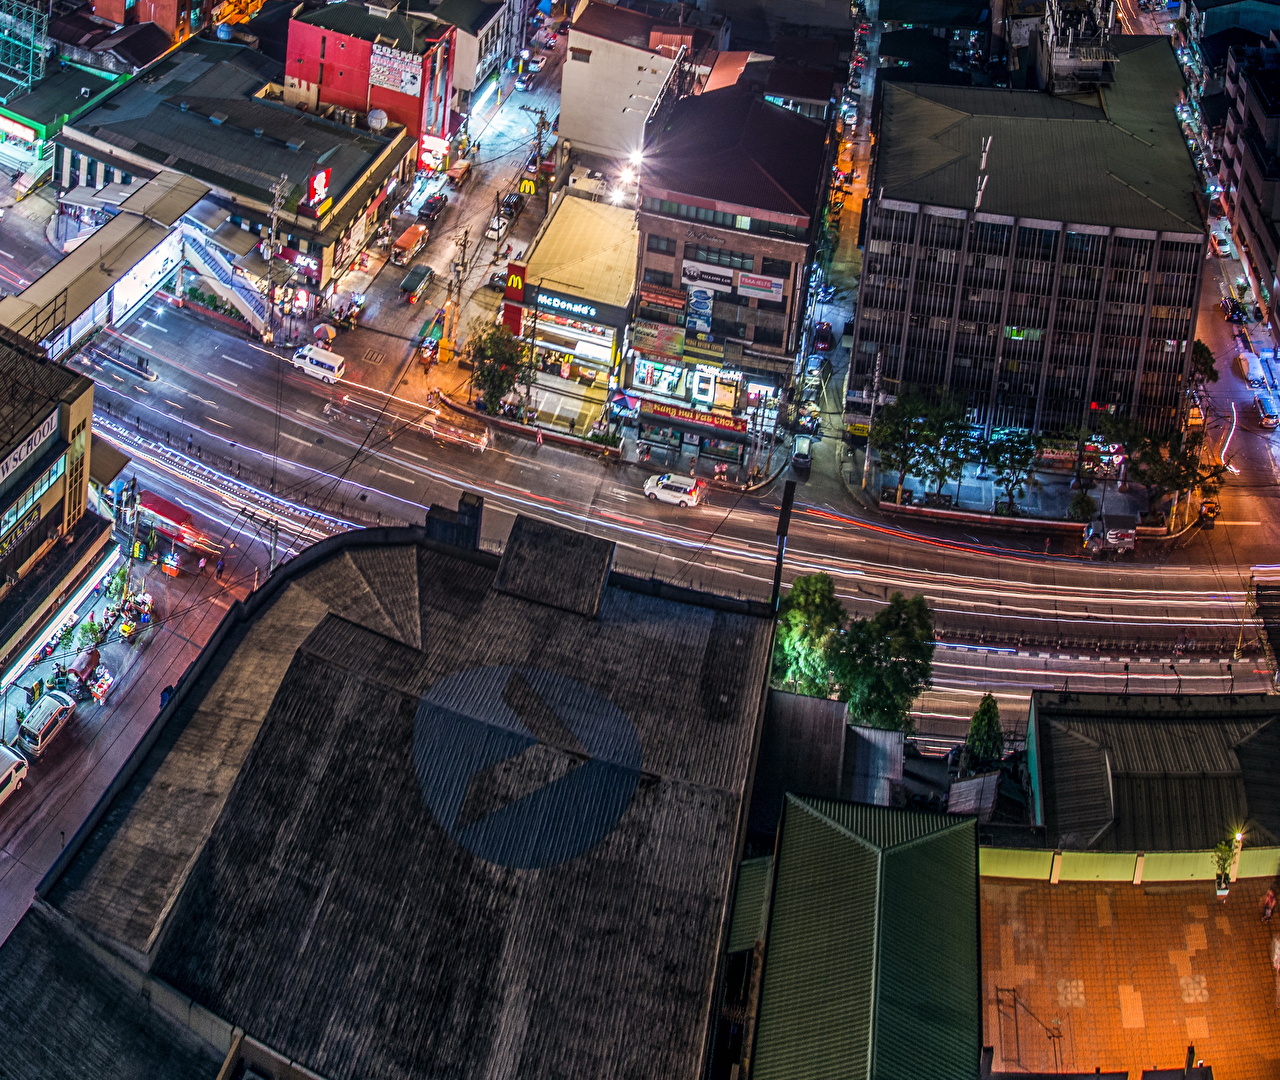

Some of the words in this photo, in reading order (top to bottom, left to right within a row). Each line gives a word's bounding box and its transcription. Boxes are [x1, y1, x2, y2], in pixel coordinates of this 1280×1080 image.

[373, 44, 422, 62] COSMO
[295, 255, 318, 270] KFC
[537, 293, 597, 317] McDonald's
[12, 415, 57, 468] SCHOOL
